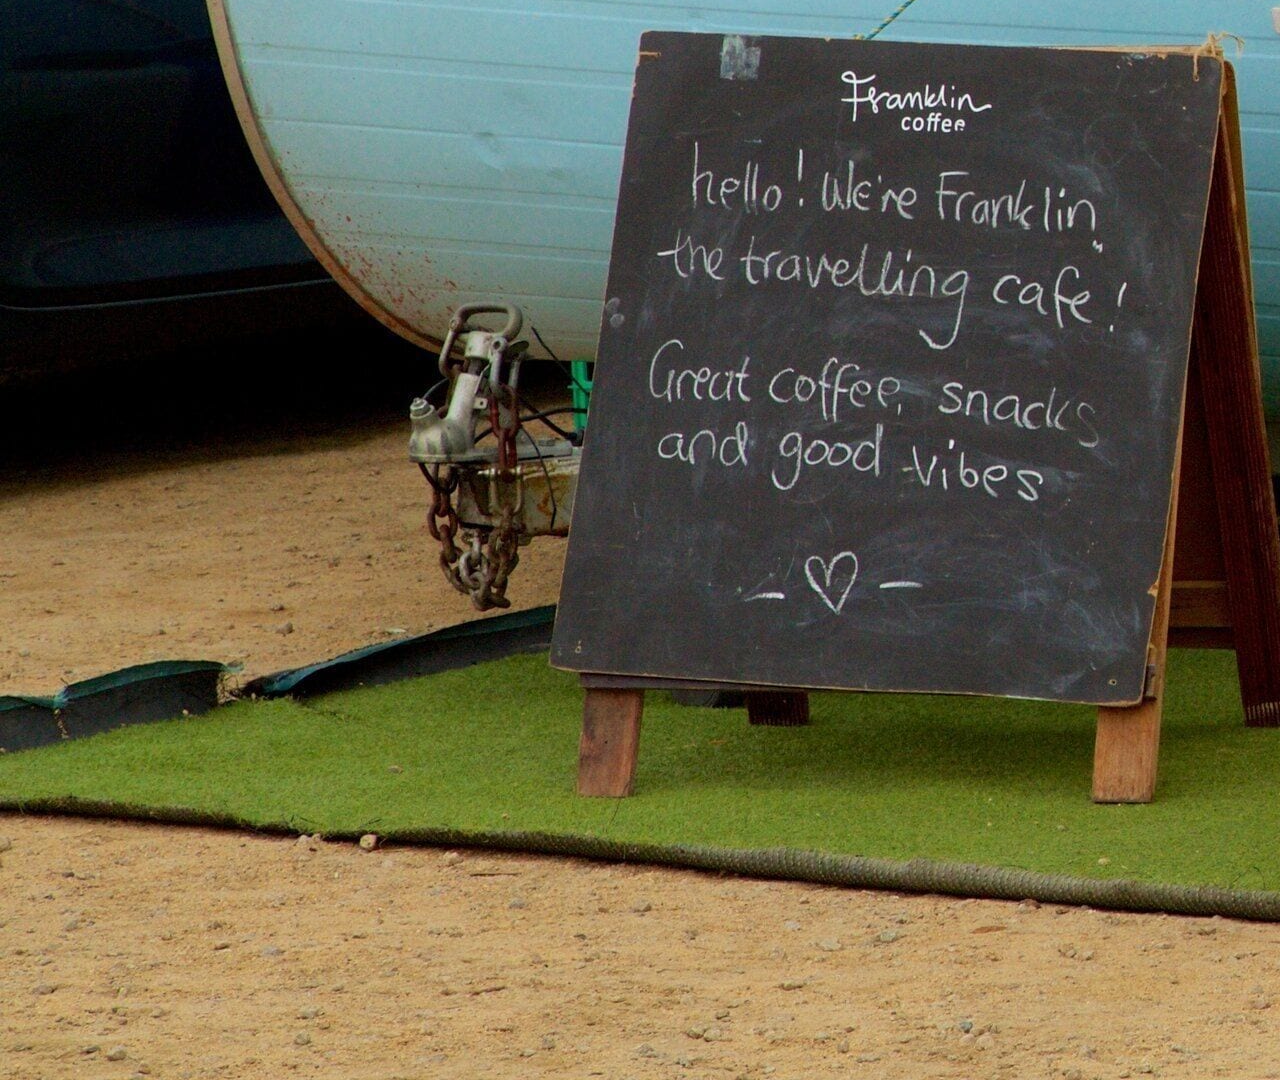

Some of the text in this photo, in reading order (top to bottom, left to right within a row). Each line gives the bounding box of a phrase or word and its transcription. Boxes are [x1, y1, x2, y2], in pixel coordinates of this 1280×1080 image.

[841, 71, 992, 122] Franklin
[900, 112, 966, 134] coffee
[692, 140, 804, 216] hello!
[822, 159, 918, 220] We're
[657, 229, 725, 281] the
[739, 235, 970, 350] travelling
[649, 340, 752, 405] Great
[938, 380, 1100, 447] snacks
[657, 421, 749, 466] and
[771, 423, 883, 491] good
